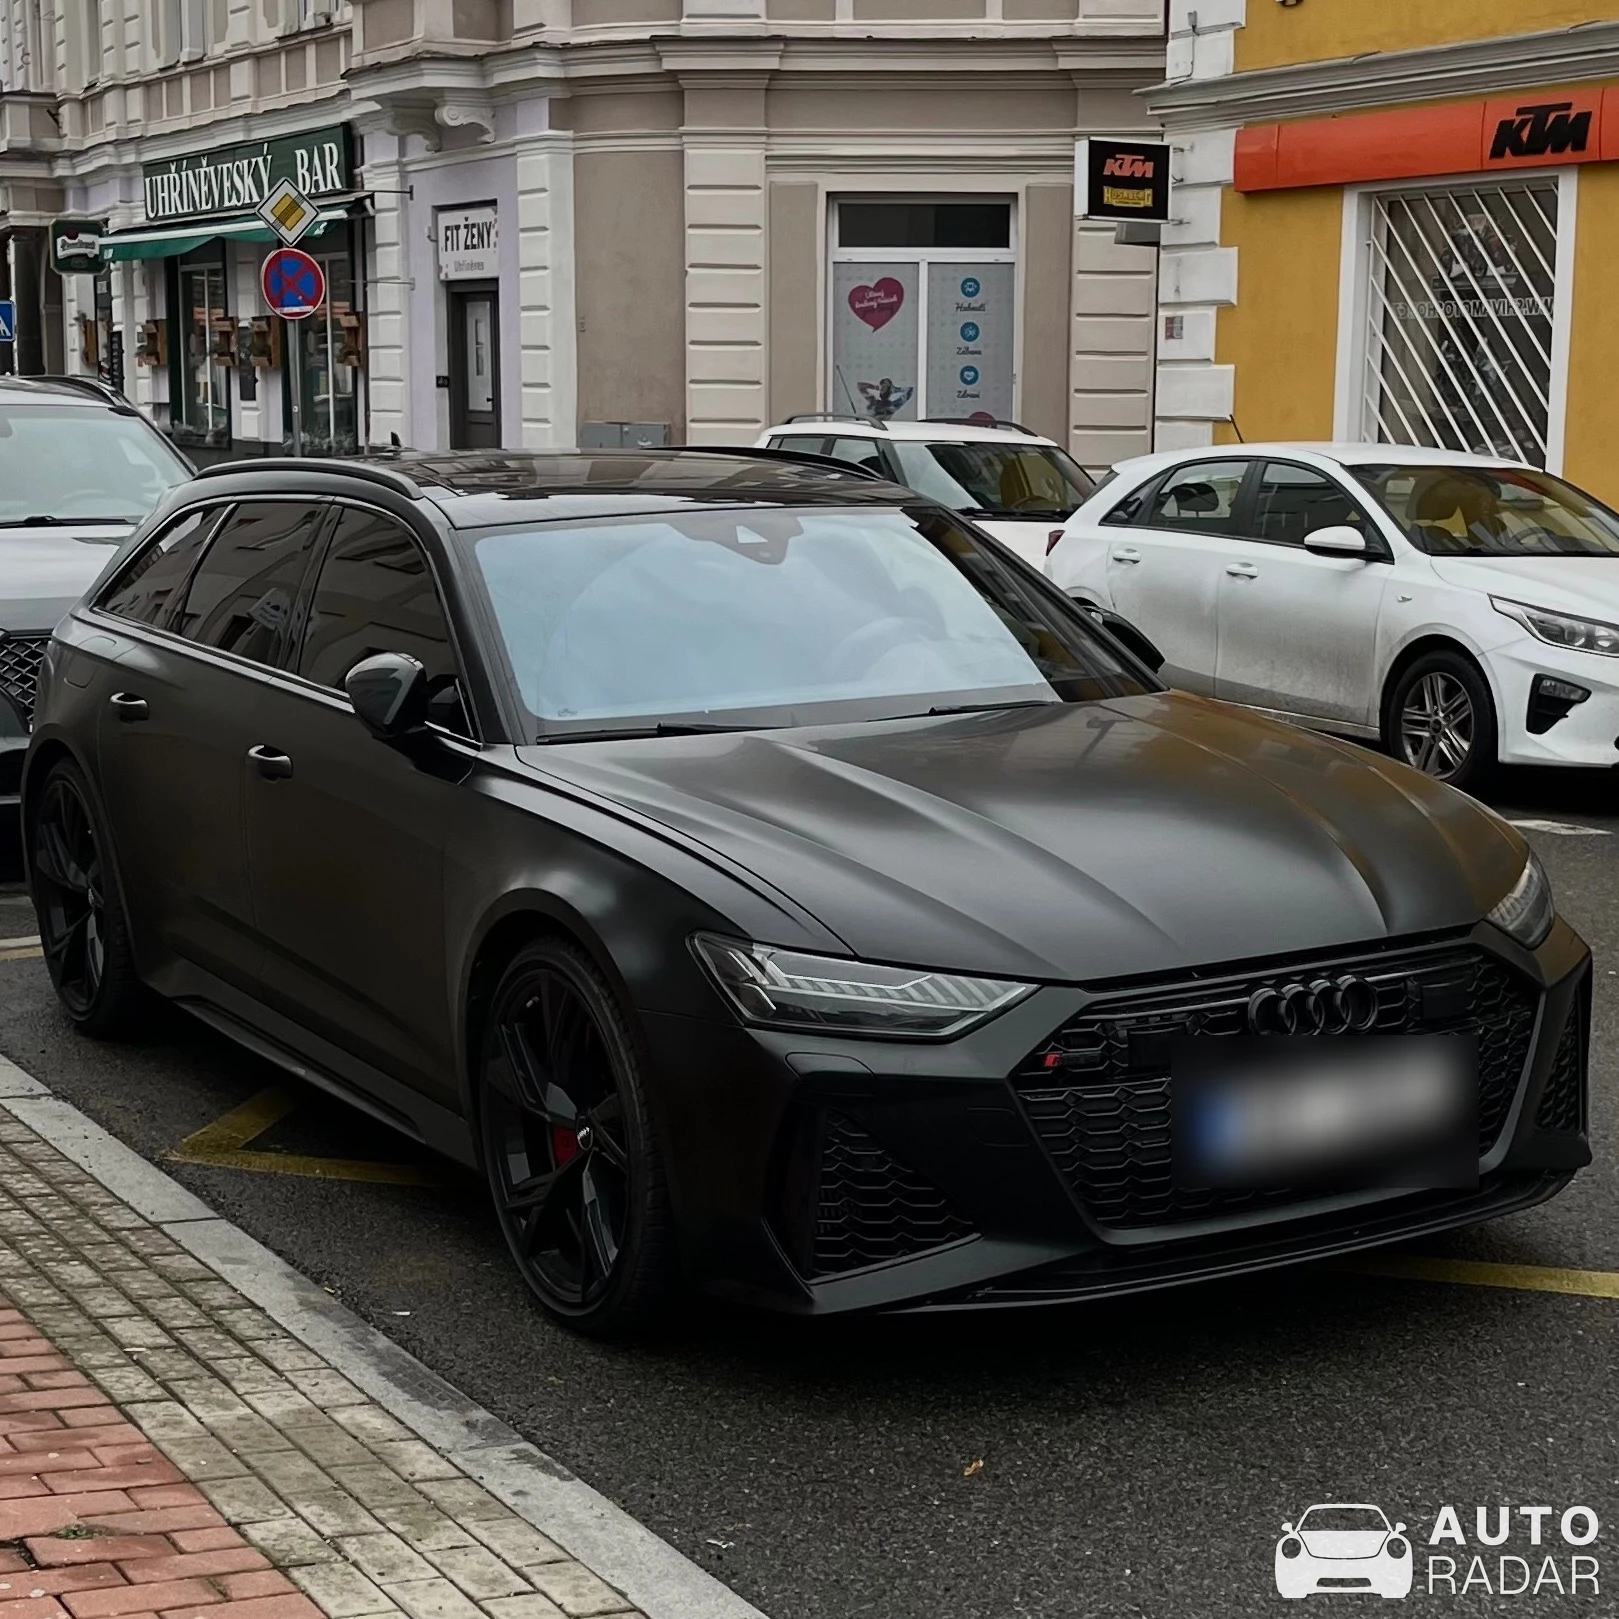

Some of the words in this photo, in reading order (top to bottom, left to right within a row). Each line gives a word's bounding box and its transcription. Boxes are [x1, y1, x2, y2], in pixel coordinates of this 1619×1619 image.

[1489, 102, 1593, 160] KTM
[145, 143, 272, 218] UHŘÍNĚVESKÝ
[295, 142, 342, 195] BAR
[1103, 154, 1154, 178] KTM
[444, 224, 461, 252] FIT
[464, 217, 492, 250] ŽENY
